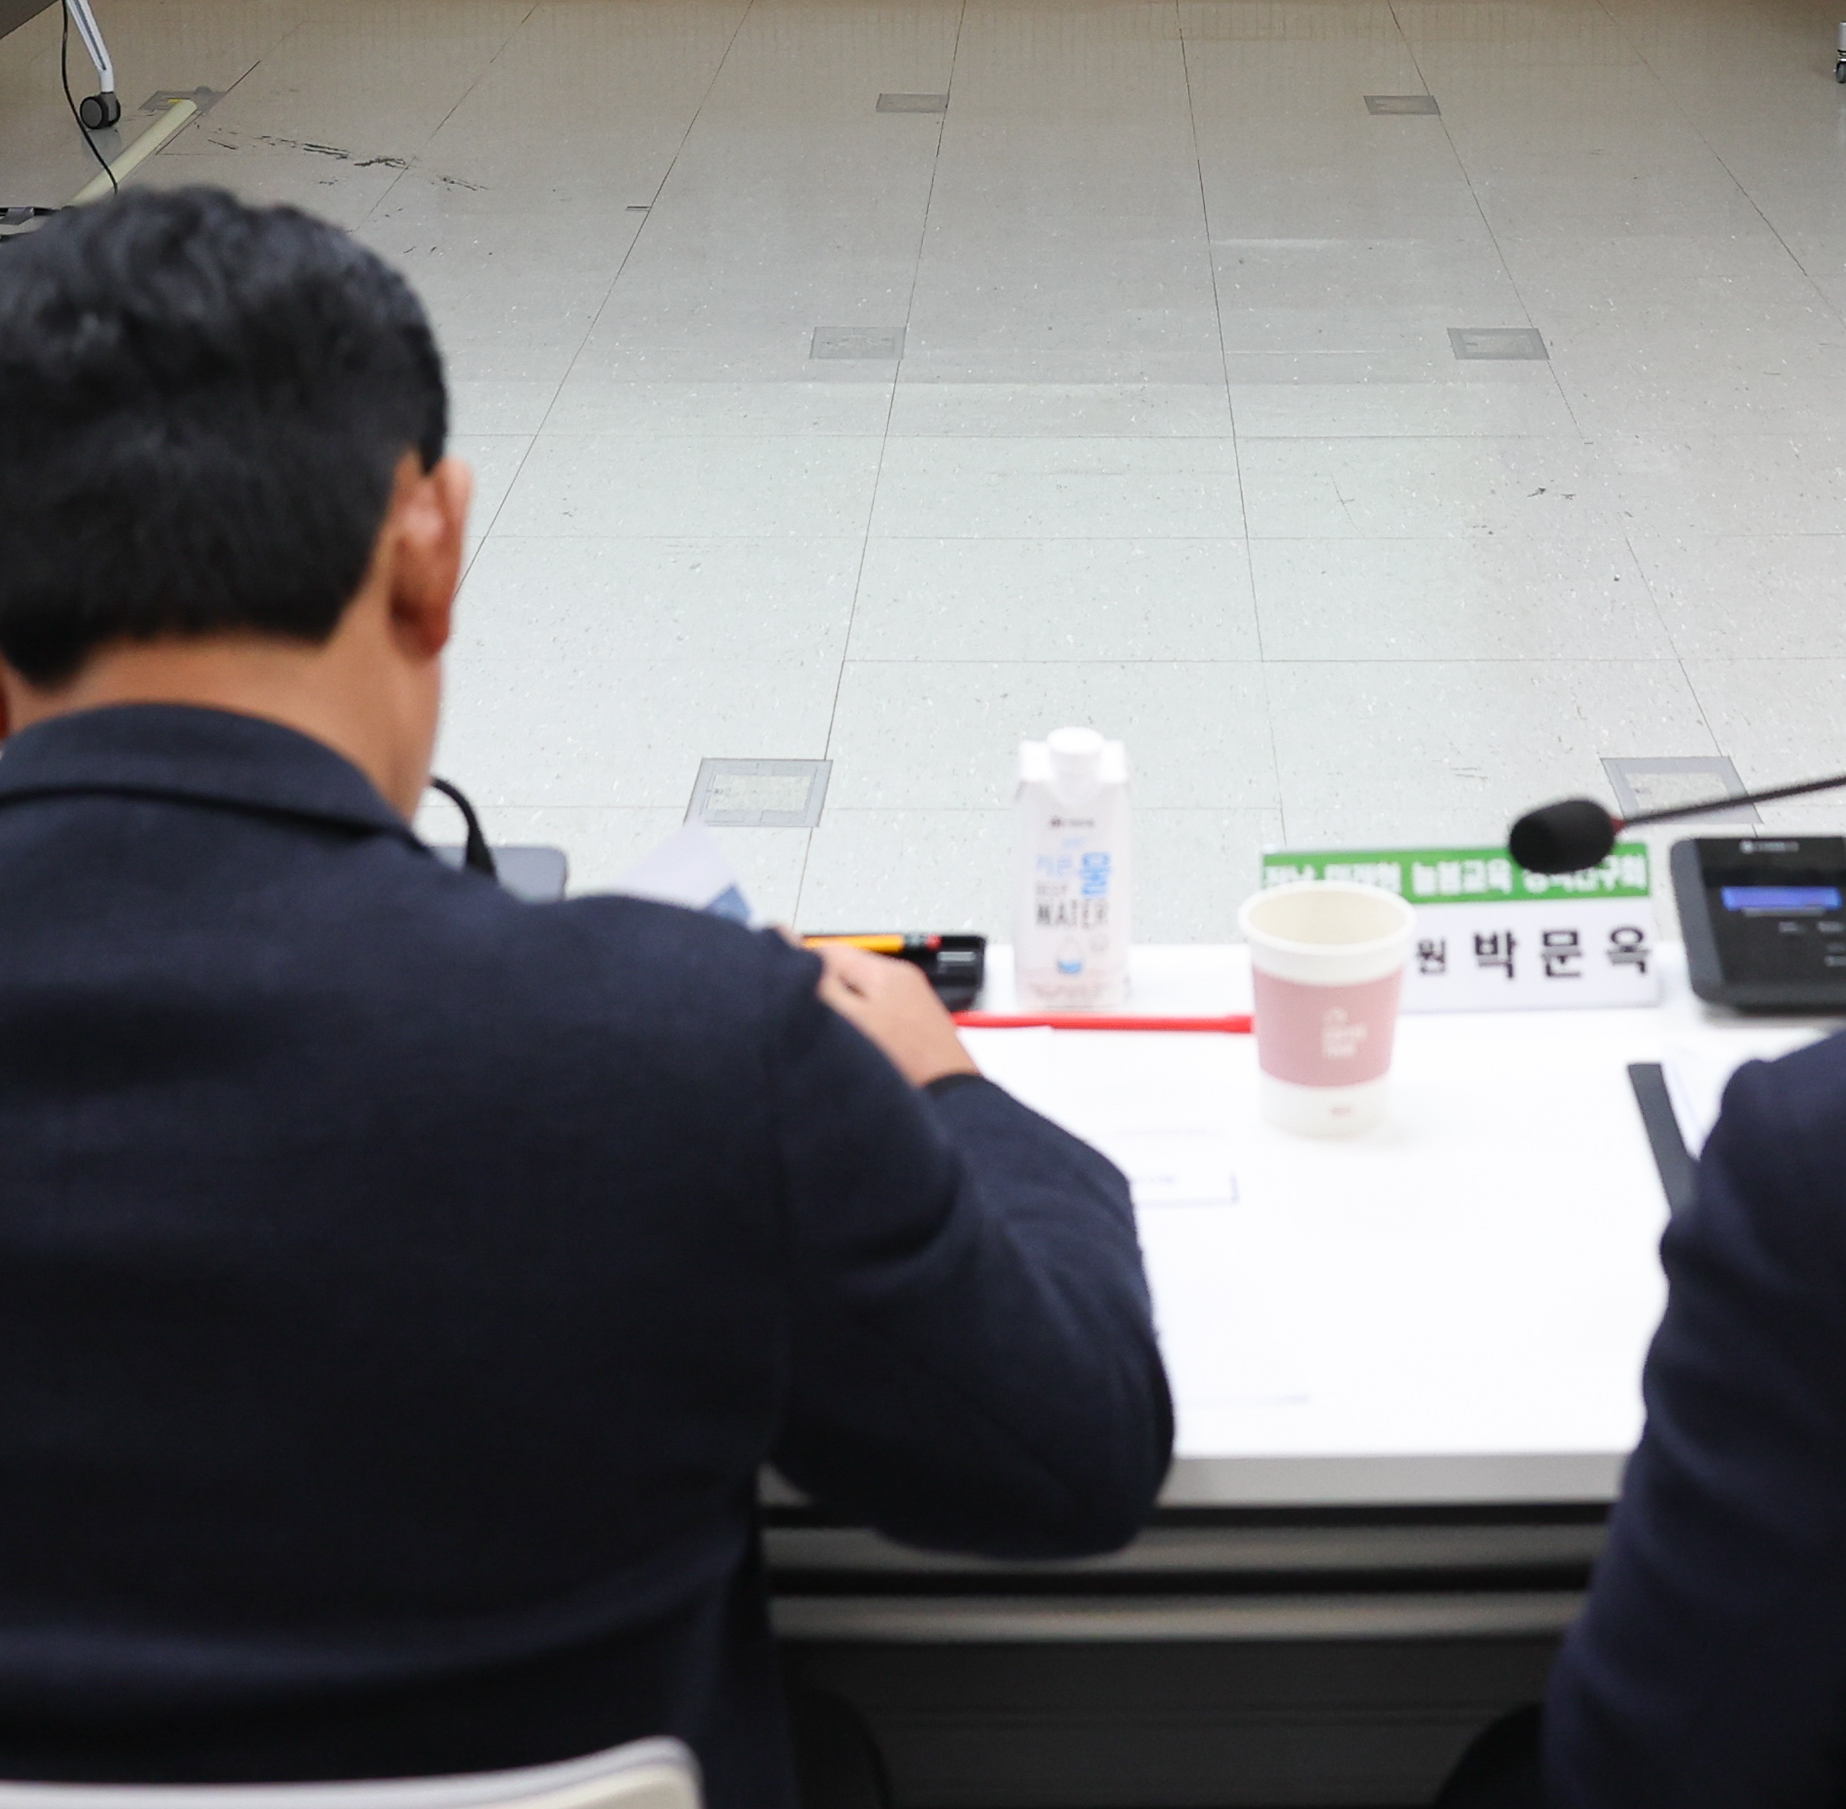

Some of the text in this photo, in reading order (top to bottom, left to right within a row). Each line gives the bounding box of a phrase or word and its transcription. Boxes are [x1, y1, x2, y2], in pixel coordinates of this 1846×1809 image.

[1410, 859, 1513, 897] 늘봄교육
[1034, 900, 1109, 930] WATER
[1472, 926, 1653, 980] 박문옥
